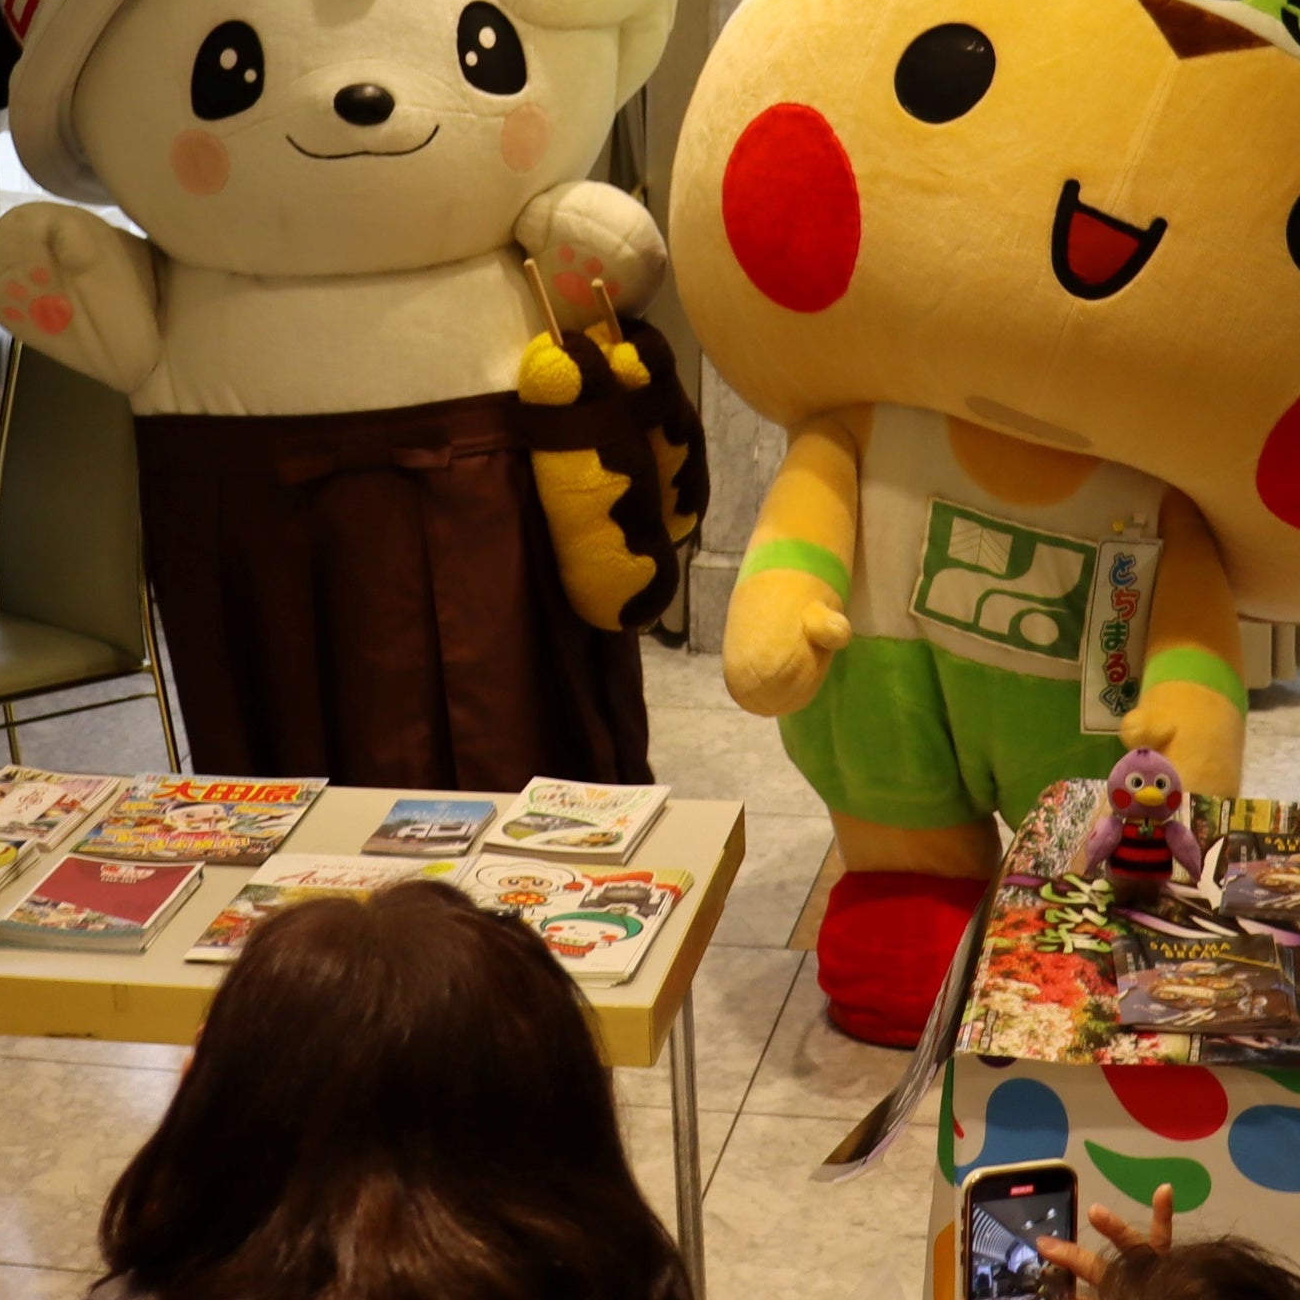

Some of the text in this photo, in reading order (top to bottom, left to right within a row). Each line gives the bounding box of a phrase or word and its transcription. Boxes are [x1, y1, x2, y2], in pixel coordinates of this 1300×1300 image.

[1100, 552, 1141, 718] とちまるくん
[150, 780, 301, 803] 大田原
